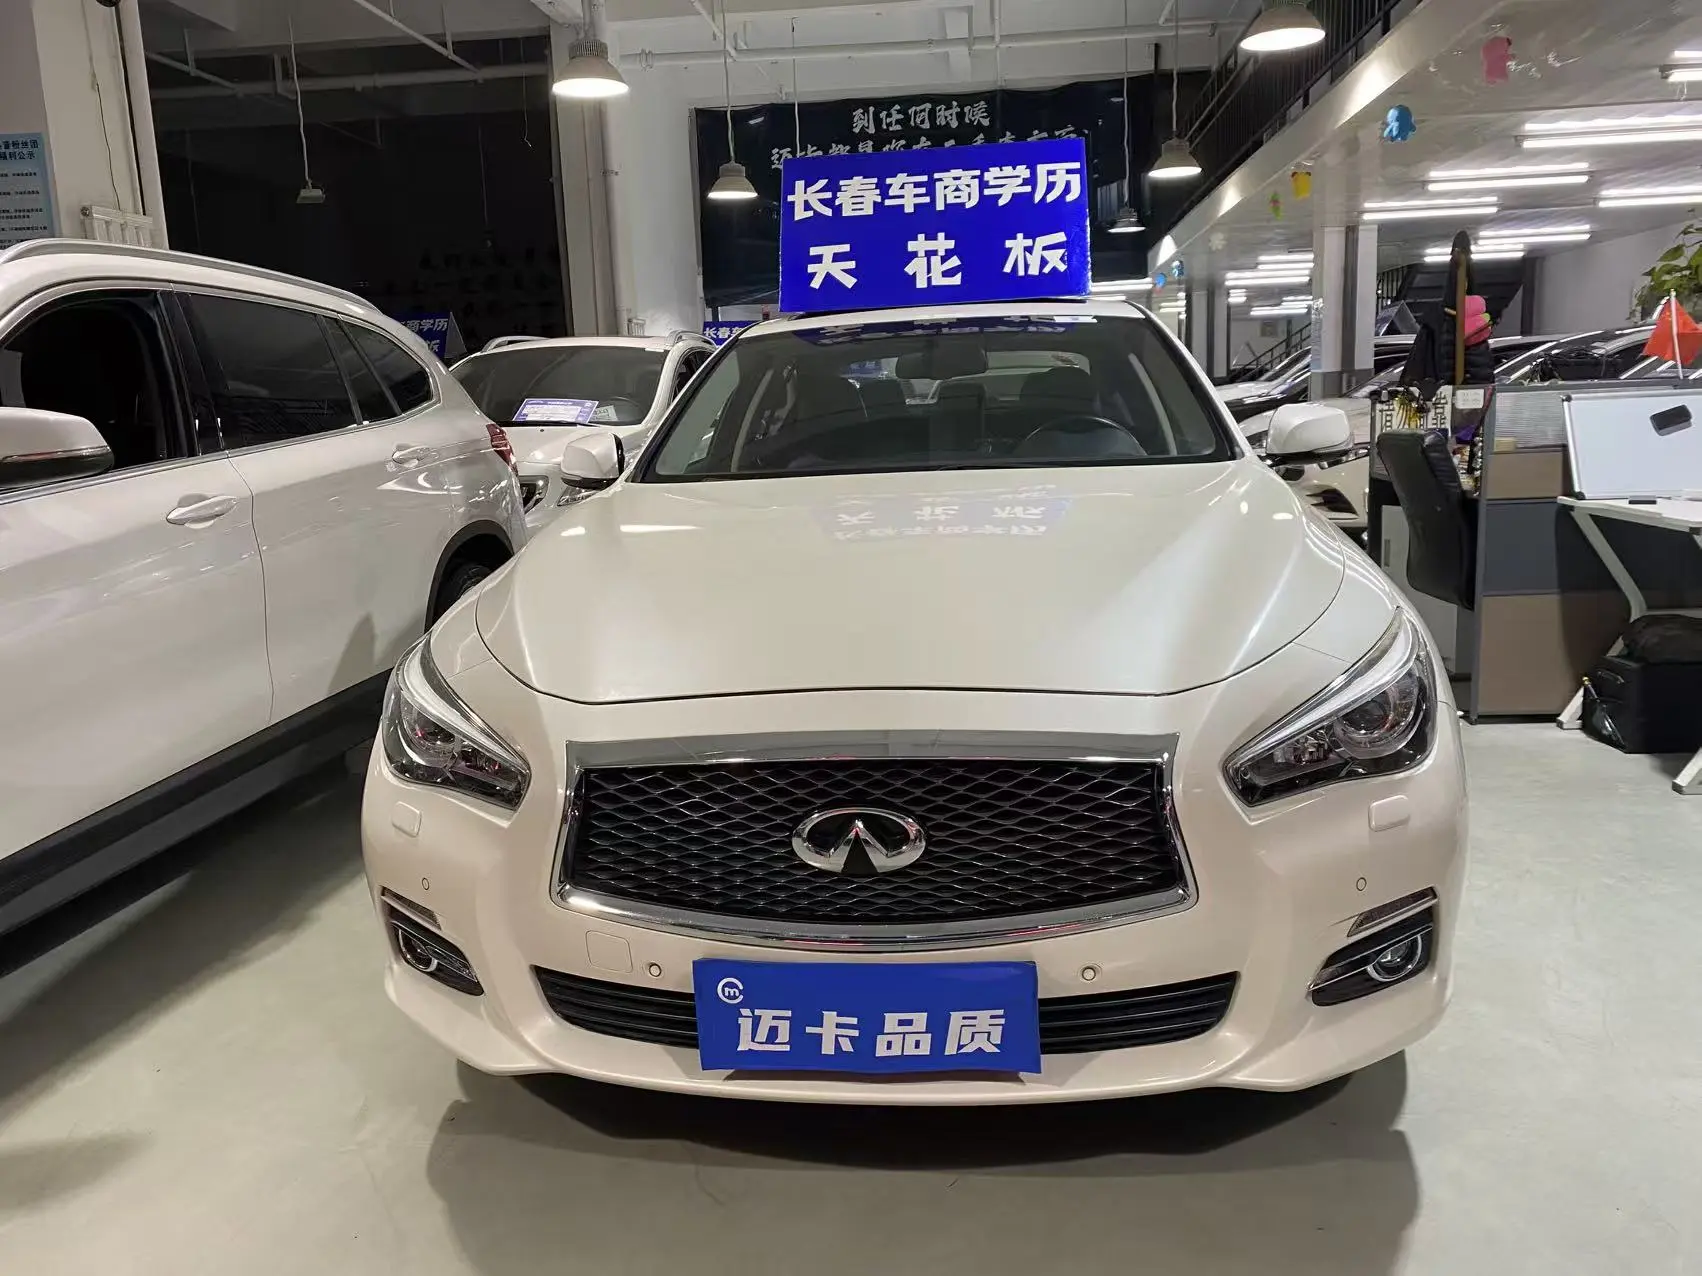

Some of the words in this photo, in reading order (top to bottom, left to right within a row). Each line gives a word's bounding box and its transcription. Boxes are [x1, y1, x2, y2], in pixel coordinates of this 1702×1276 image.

[852, 100, 990, 134] 到任何时候
[787, 161, 1081, 222] 长春车商学历
[808, 232, 1068, 289] 天花板
[401, 318, 448, 333] 商学历
[736, 1008, 1006, 1057] 迈卡品质
